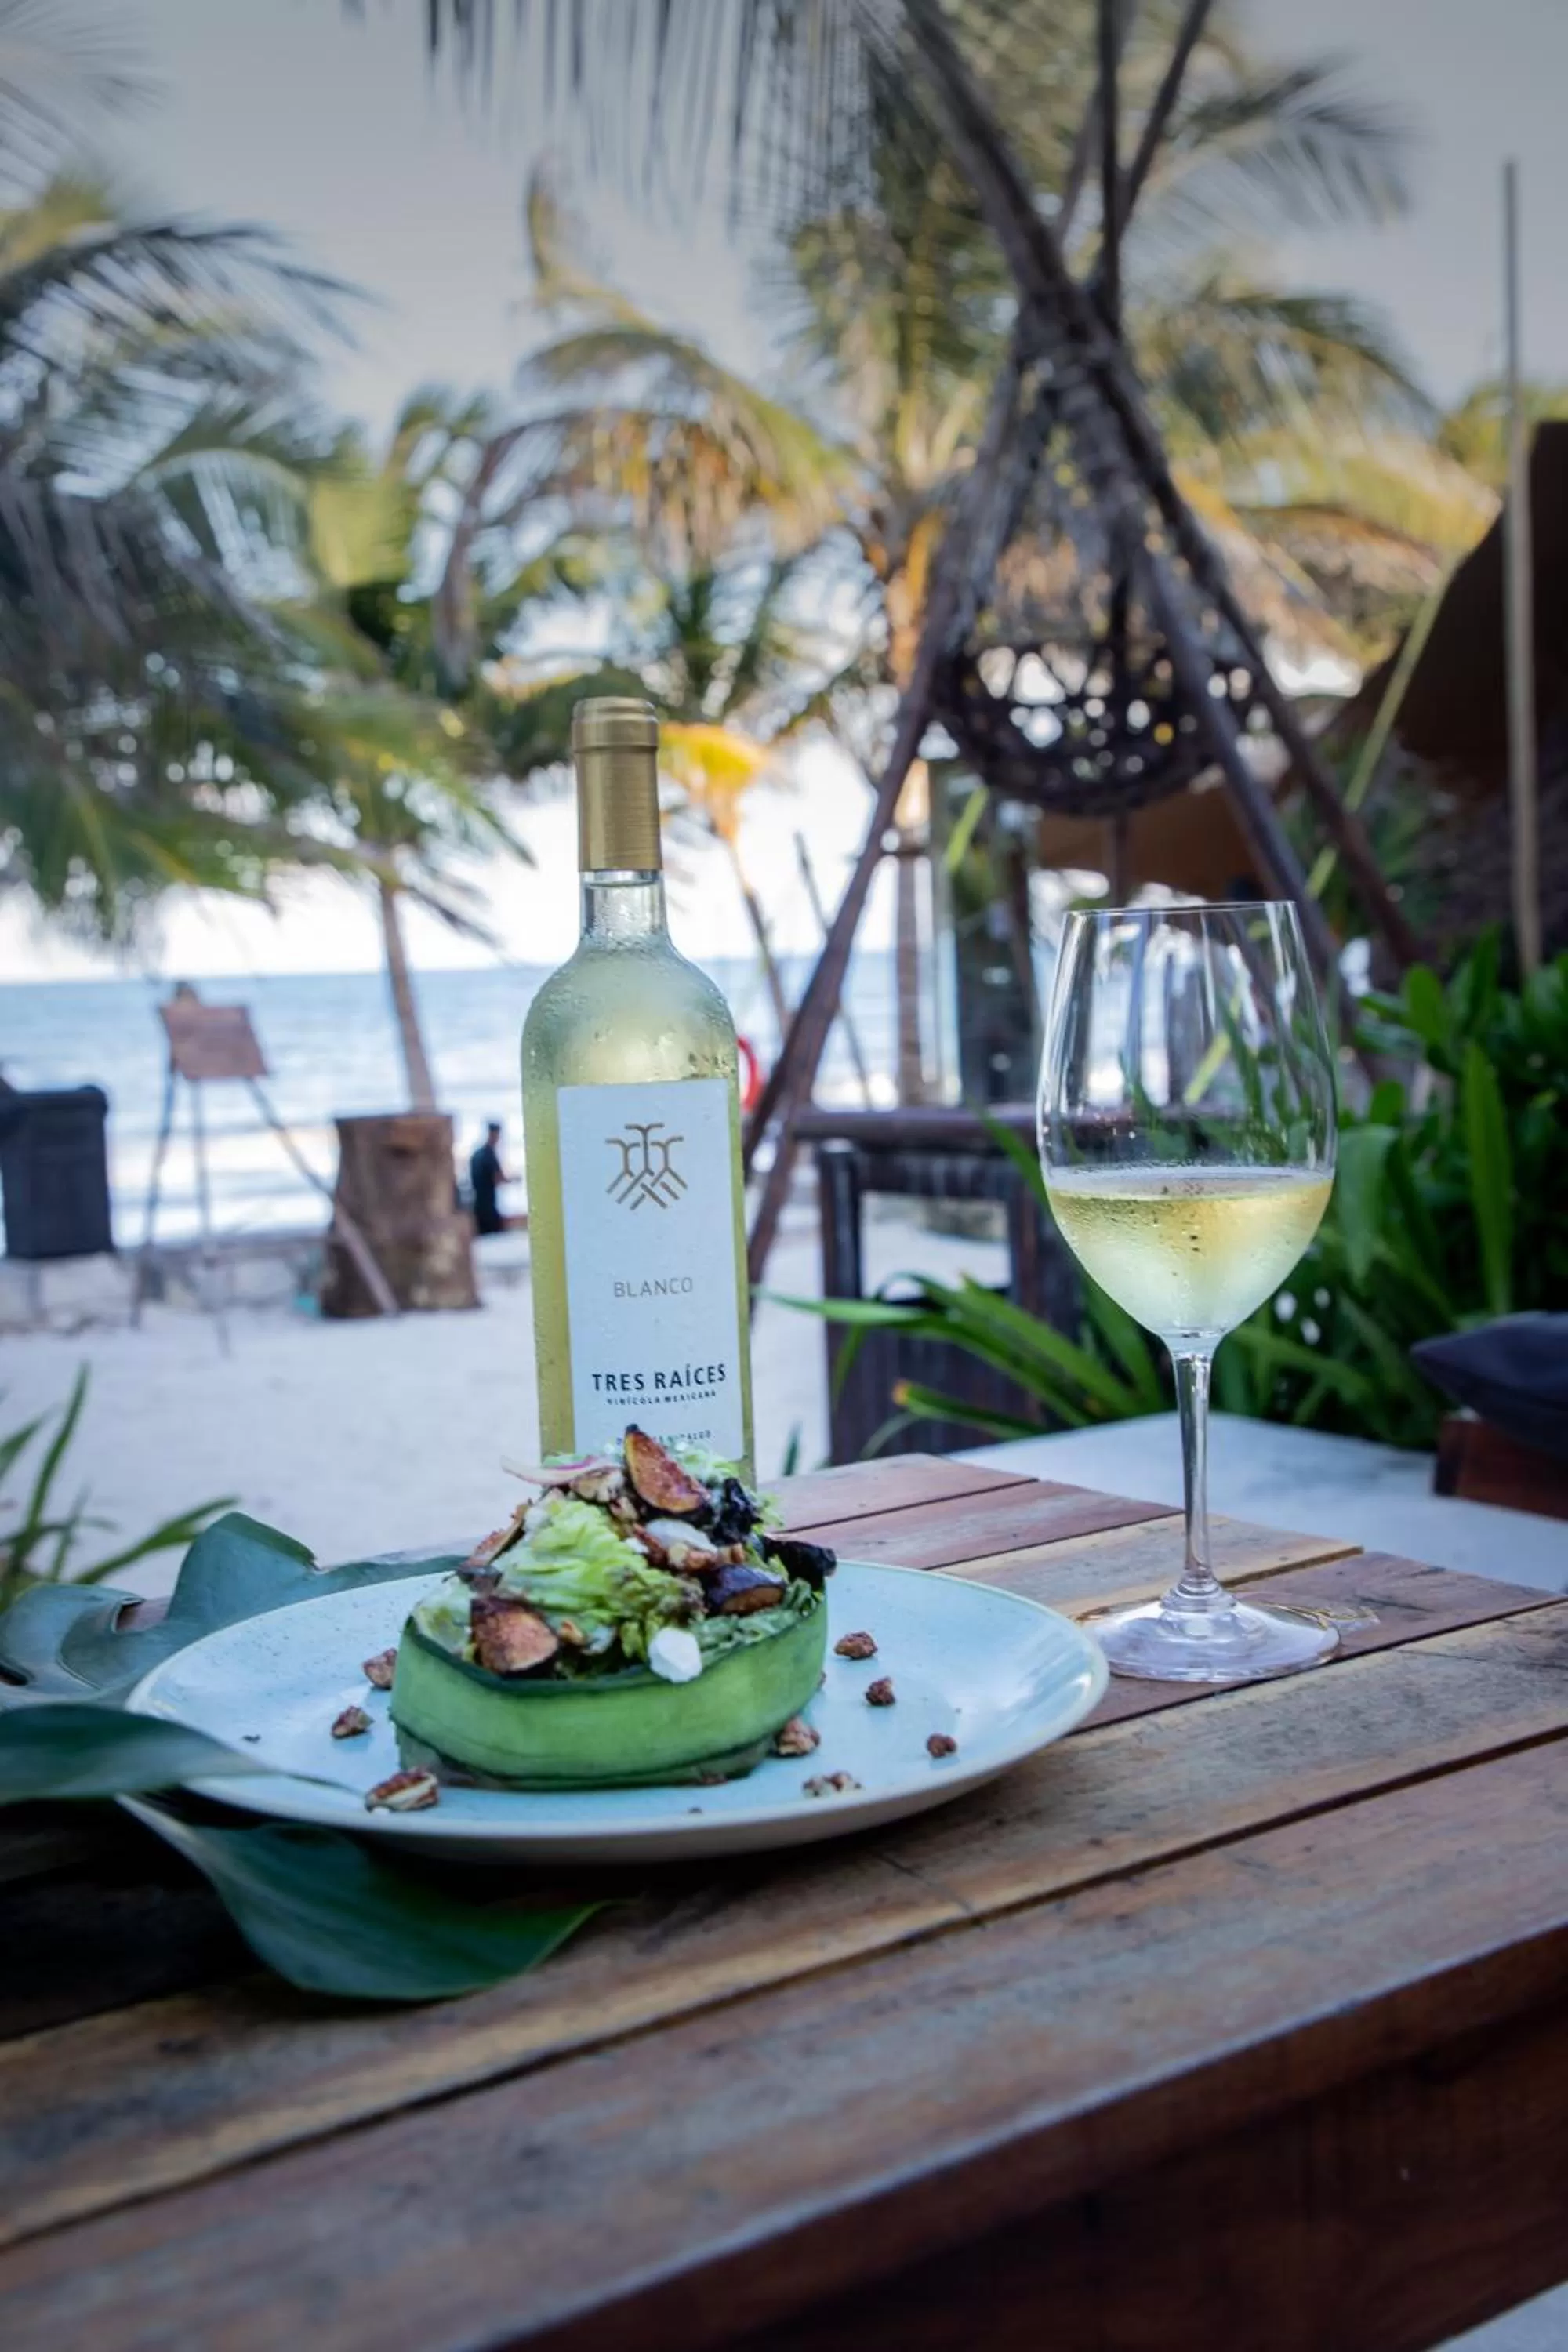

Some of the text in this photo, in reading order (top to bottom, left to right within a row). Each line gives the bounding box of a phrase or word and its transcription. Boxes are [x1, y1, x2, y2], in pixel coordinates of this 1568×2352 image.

[614, 1277, 693, 1298] BLANCO
[592, 1363, 726, 1391] TRES RAÍCES
